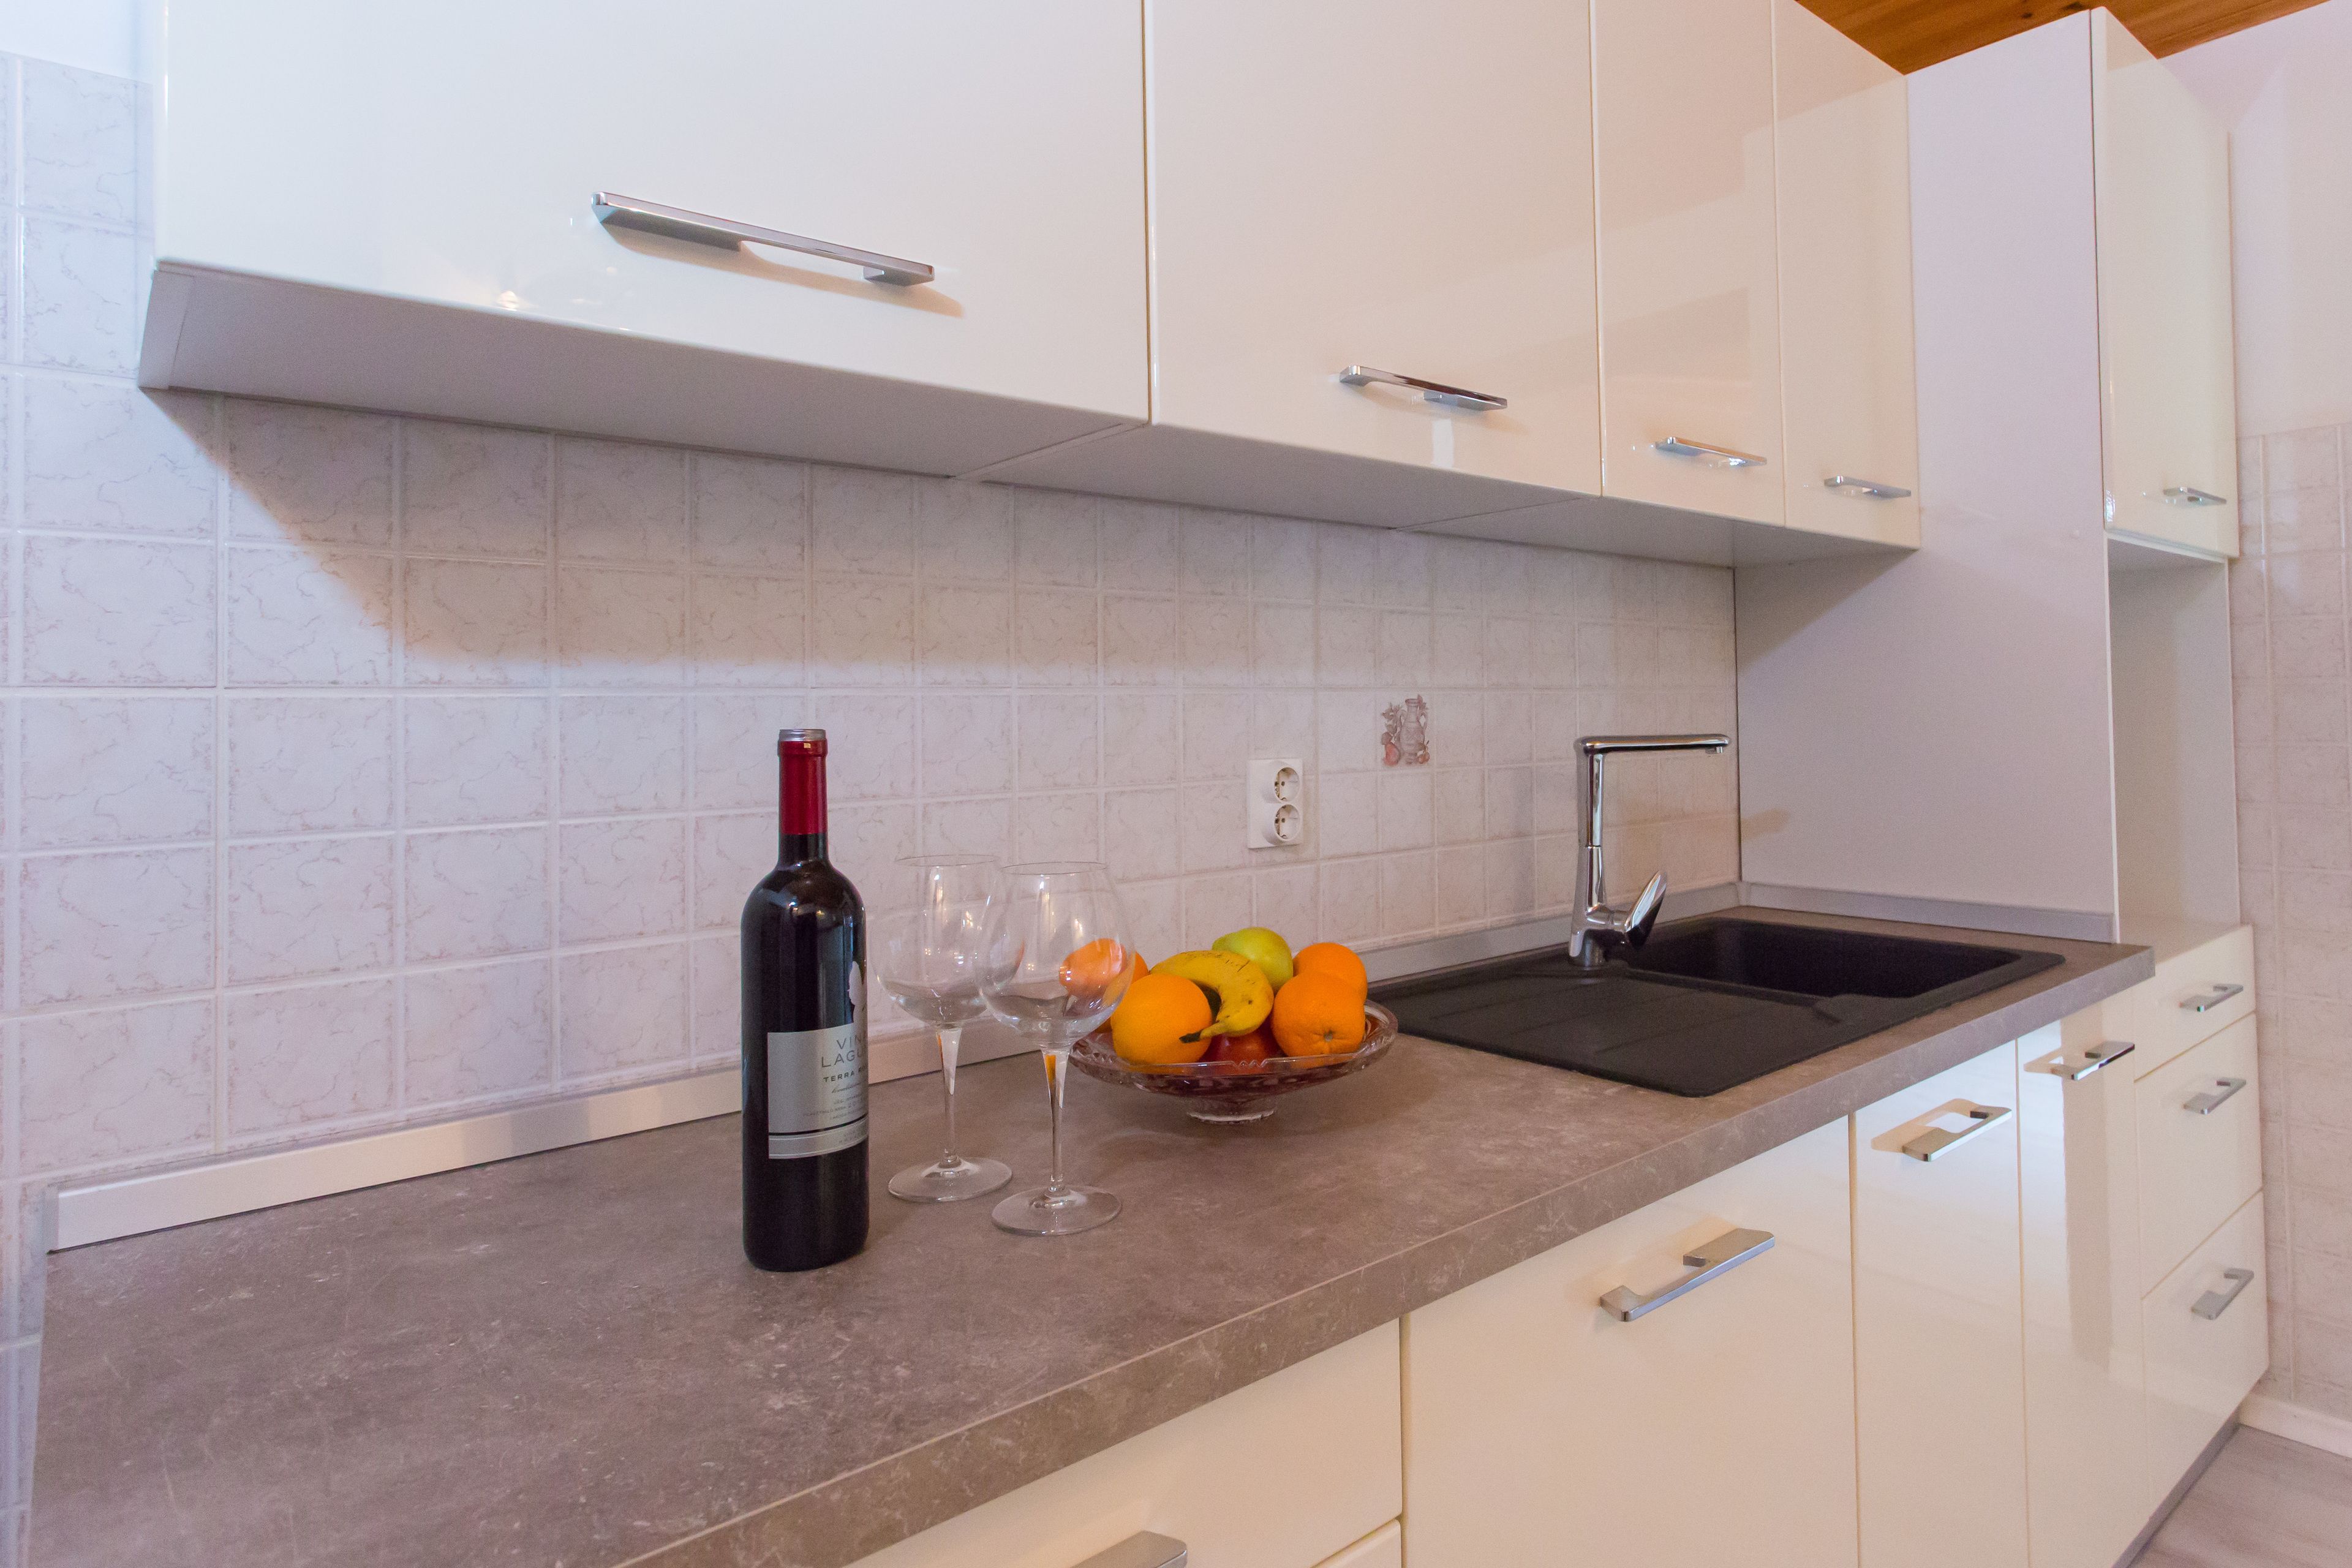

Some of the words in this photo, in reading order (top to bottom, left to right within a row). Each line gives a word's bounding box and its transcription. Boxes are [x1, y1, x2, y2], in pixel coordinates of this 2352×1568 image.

[836, 1035, 864, 1049] VIN
[821, 1048, 864, 1068] LAGU
[823, 1070, 855, 1083] TERRA
